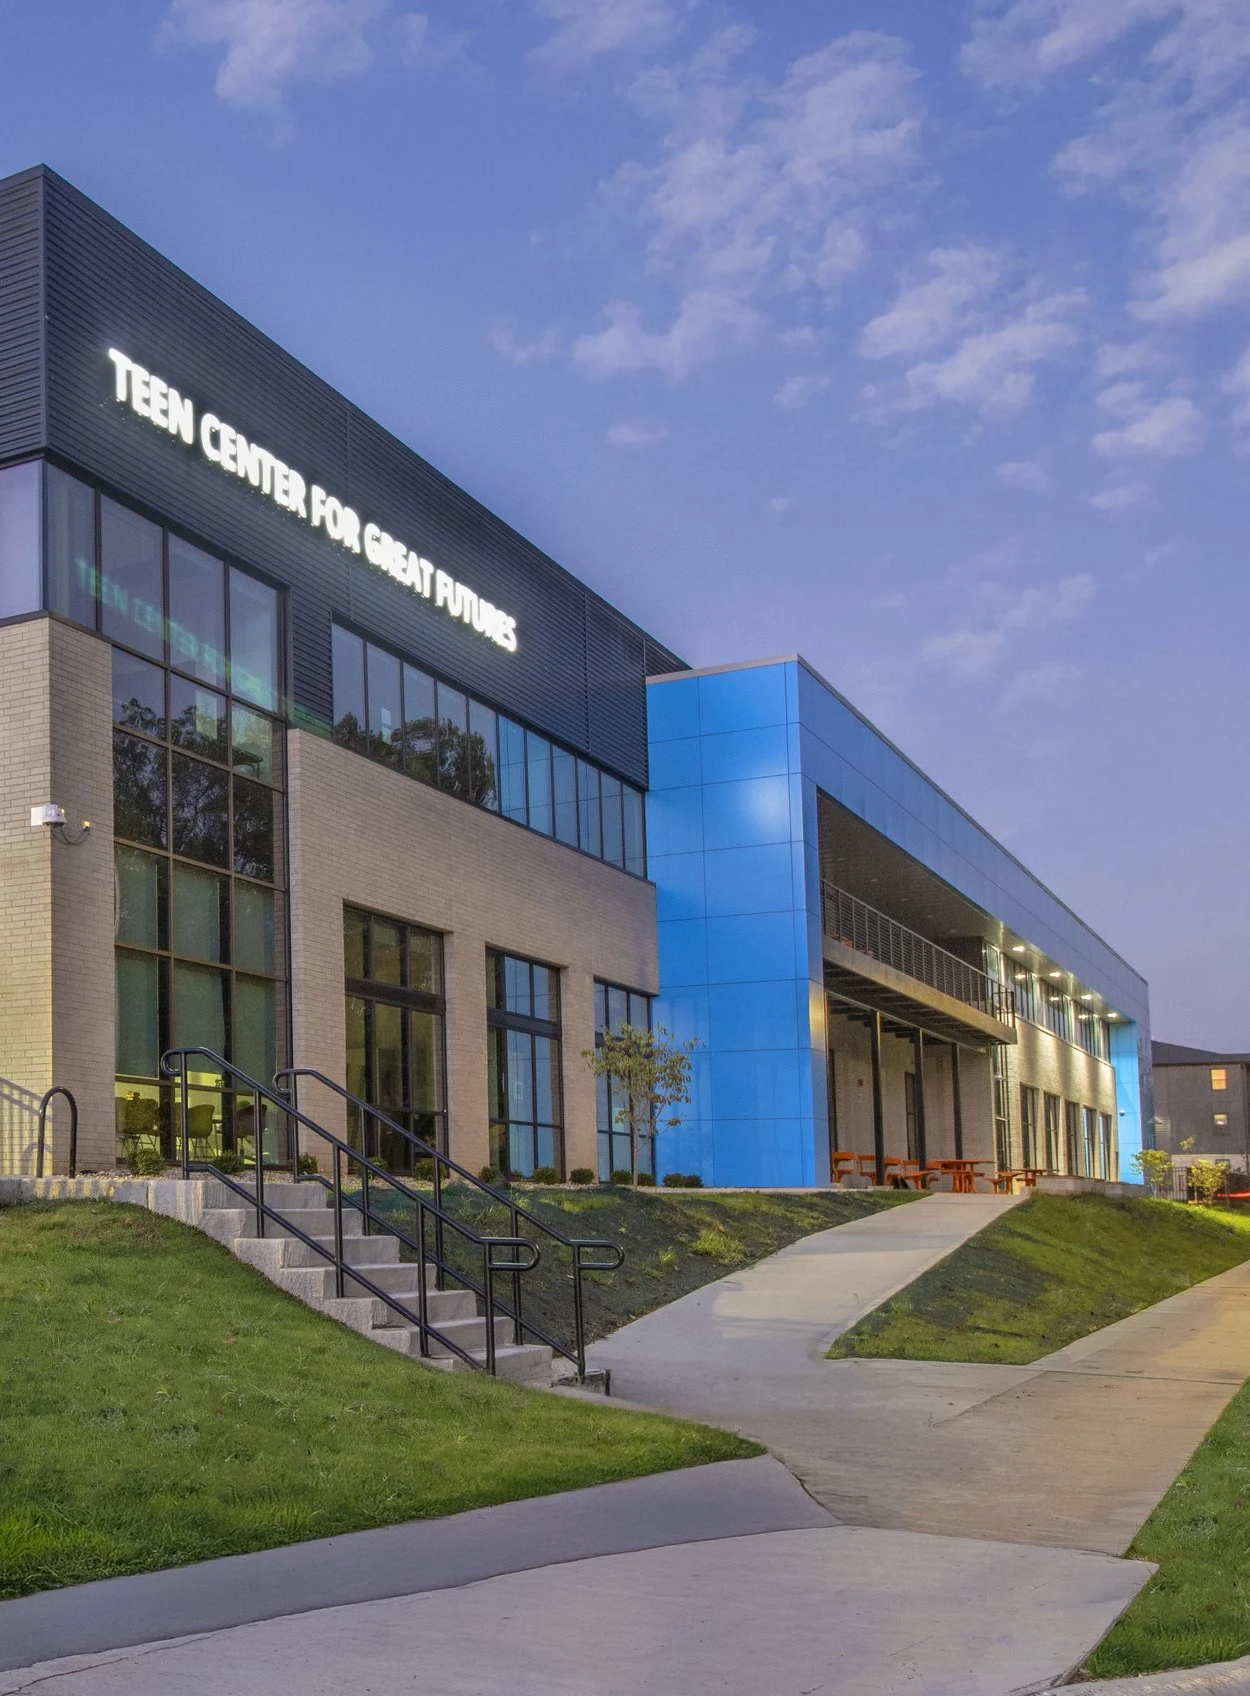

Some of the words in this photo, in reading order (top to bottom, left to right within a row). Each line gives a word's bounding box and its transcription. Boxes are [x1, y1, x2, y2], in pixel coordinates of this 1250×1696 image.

[108, 347, 194, 445] TEEN
[200, 413, 307, 518] CENTER
[311, 483, 362, 554] FOR
[363, 522, 434, 599] GREAT
[436, 568, 518, 653] FUTURES
